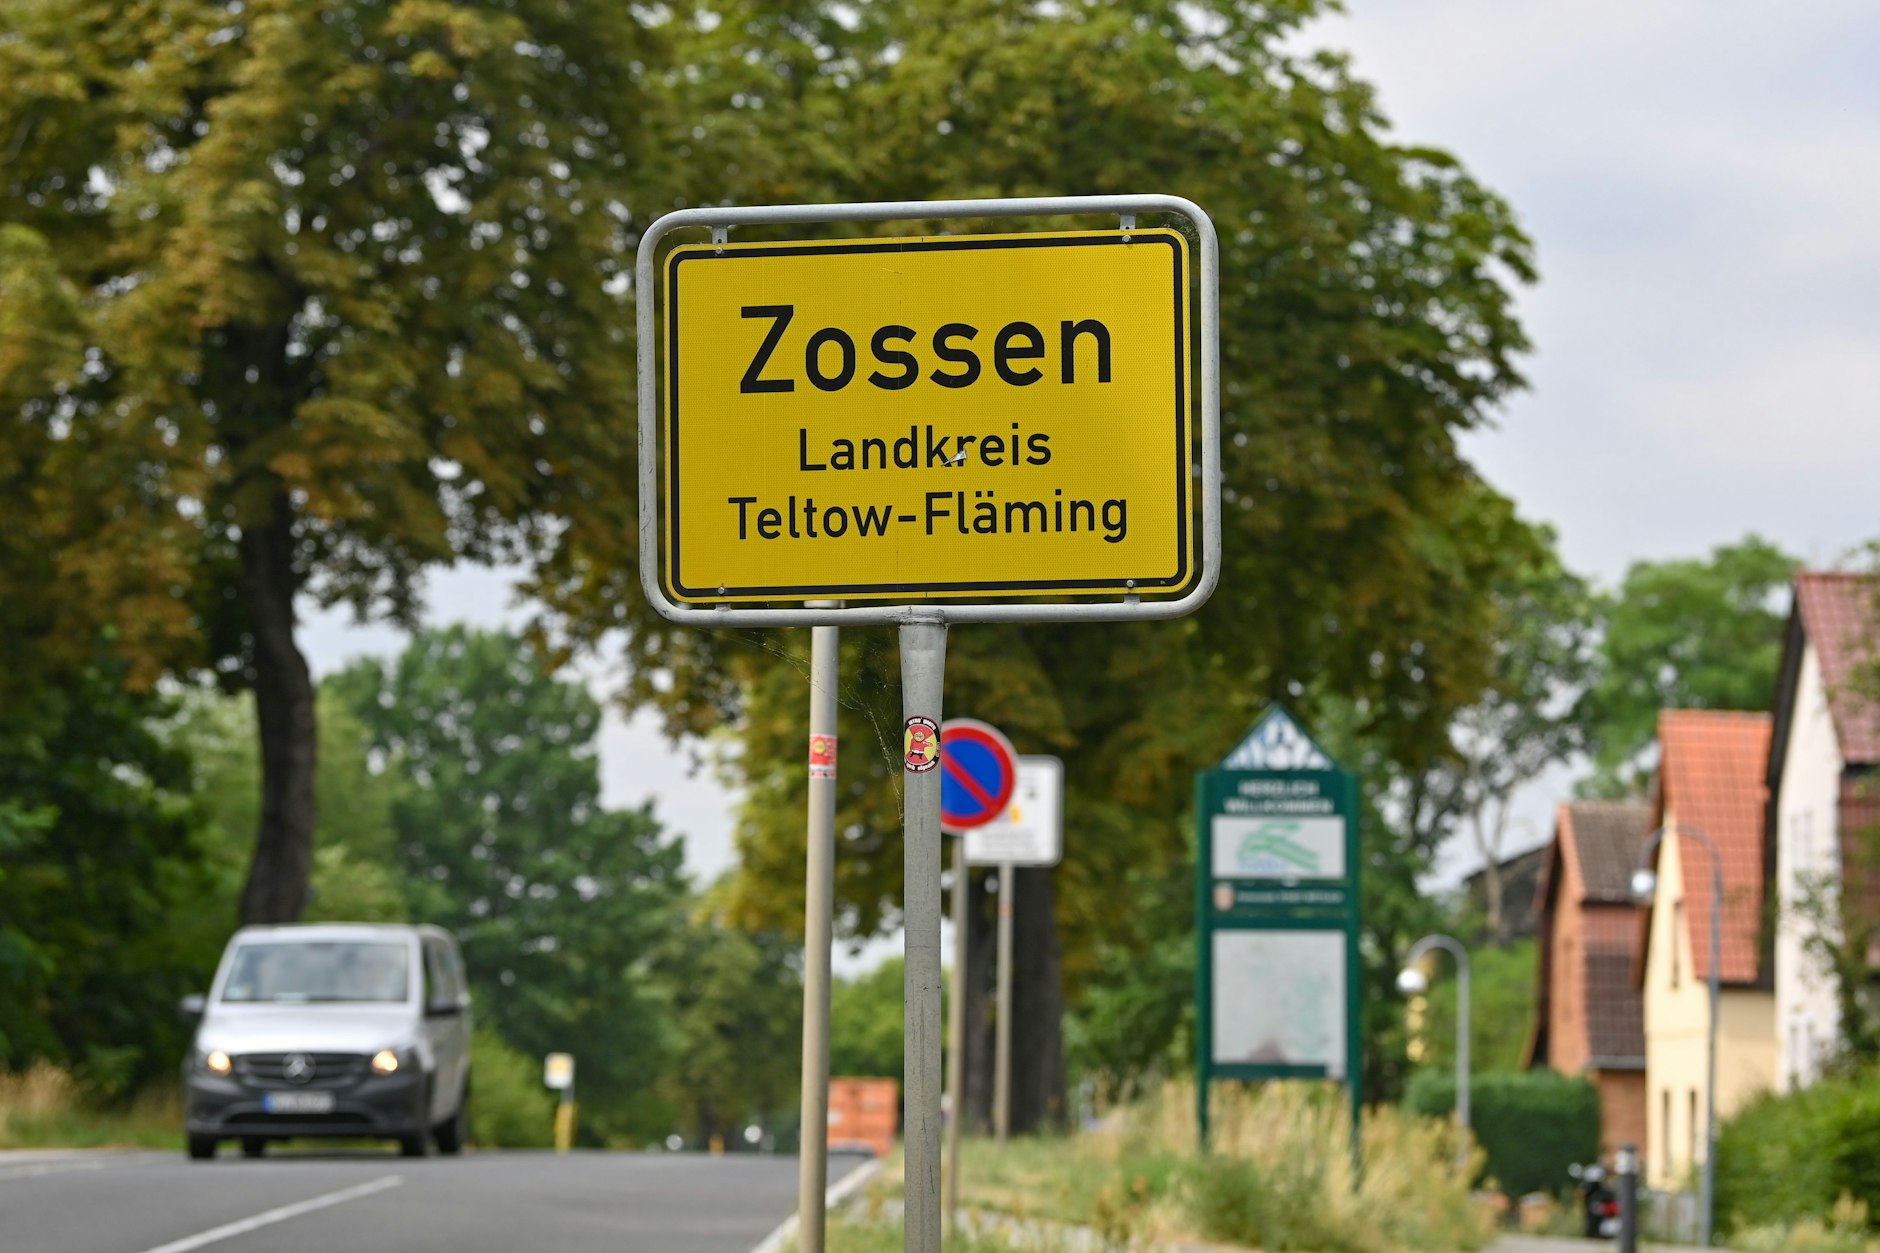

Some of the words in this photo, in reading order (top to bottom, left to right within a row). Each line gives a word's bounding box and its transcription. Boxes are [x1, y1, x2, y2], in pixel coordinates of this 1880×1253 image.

[740, 304, 1112, 394] Zossen
[799, 422, 1052, 472] Landkreis
[727, 488, 1127, 544] Teltow-Fläming
